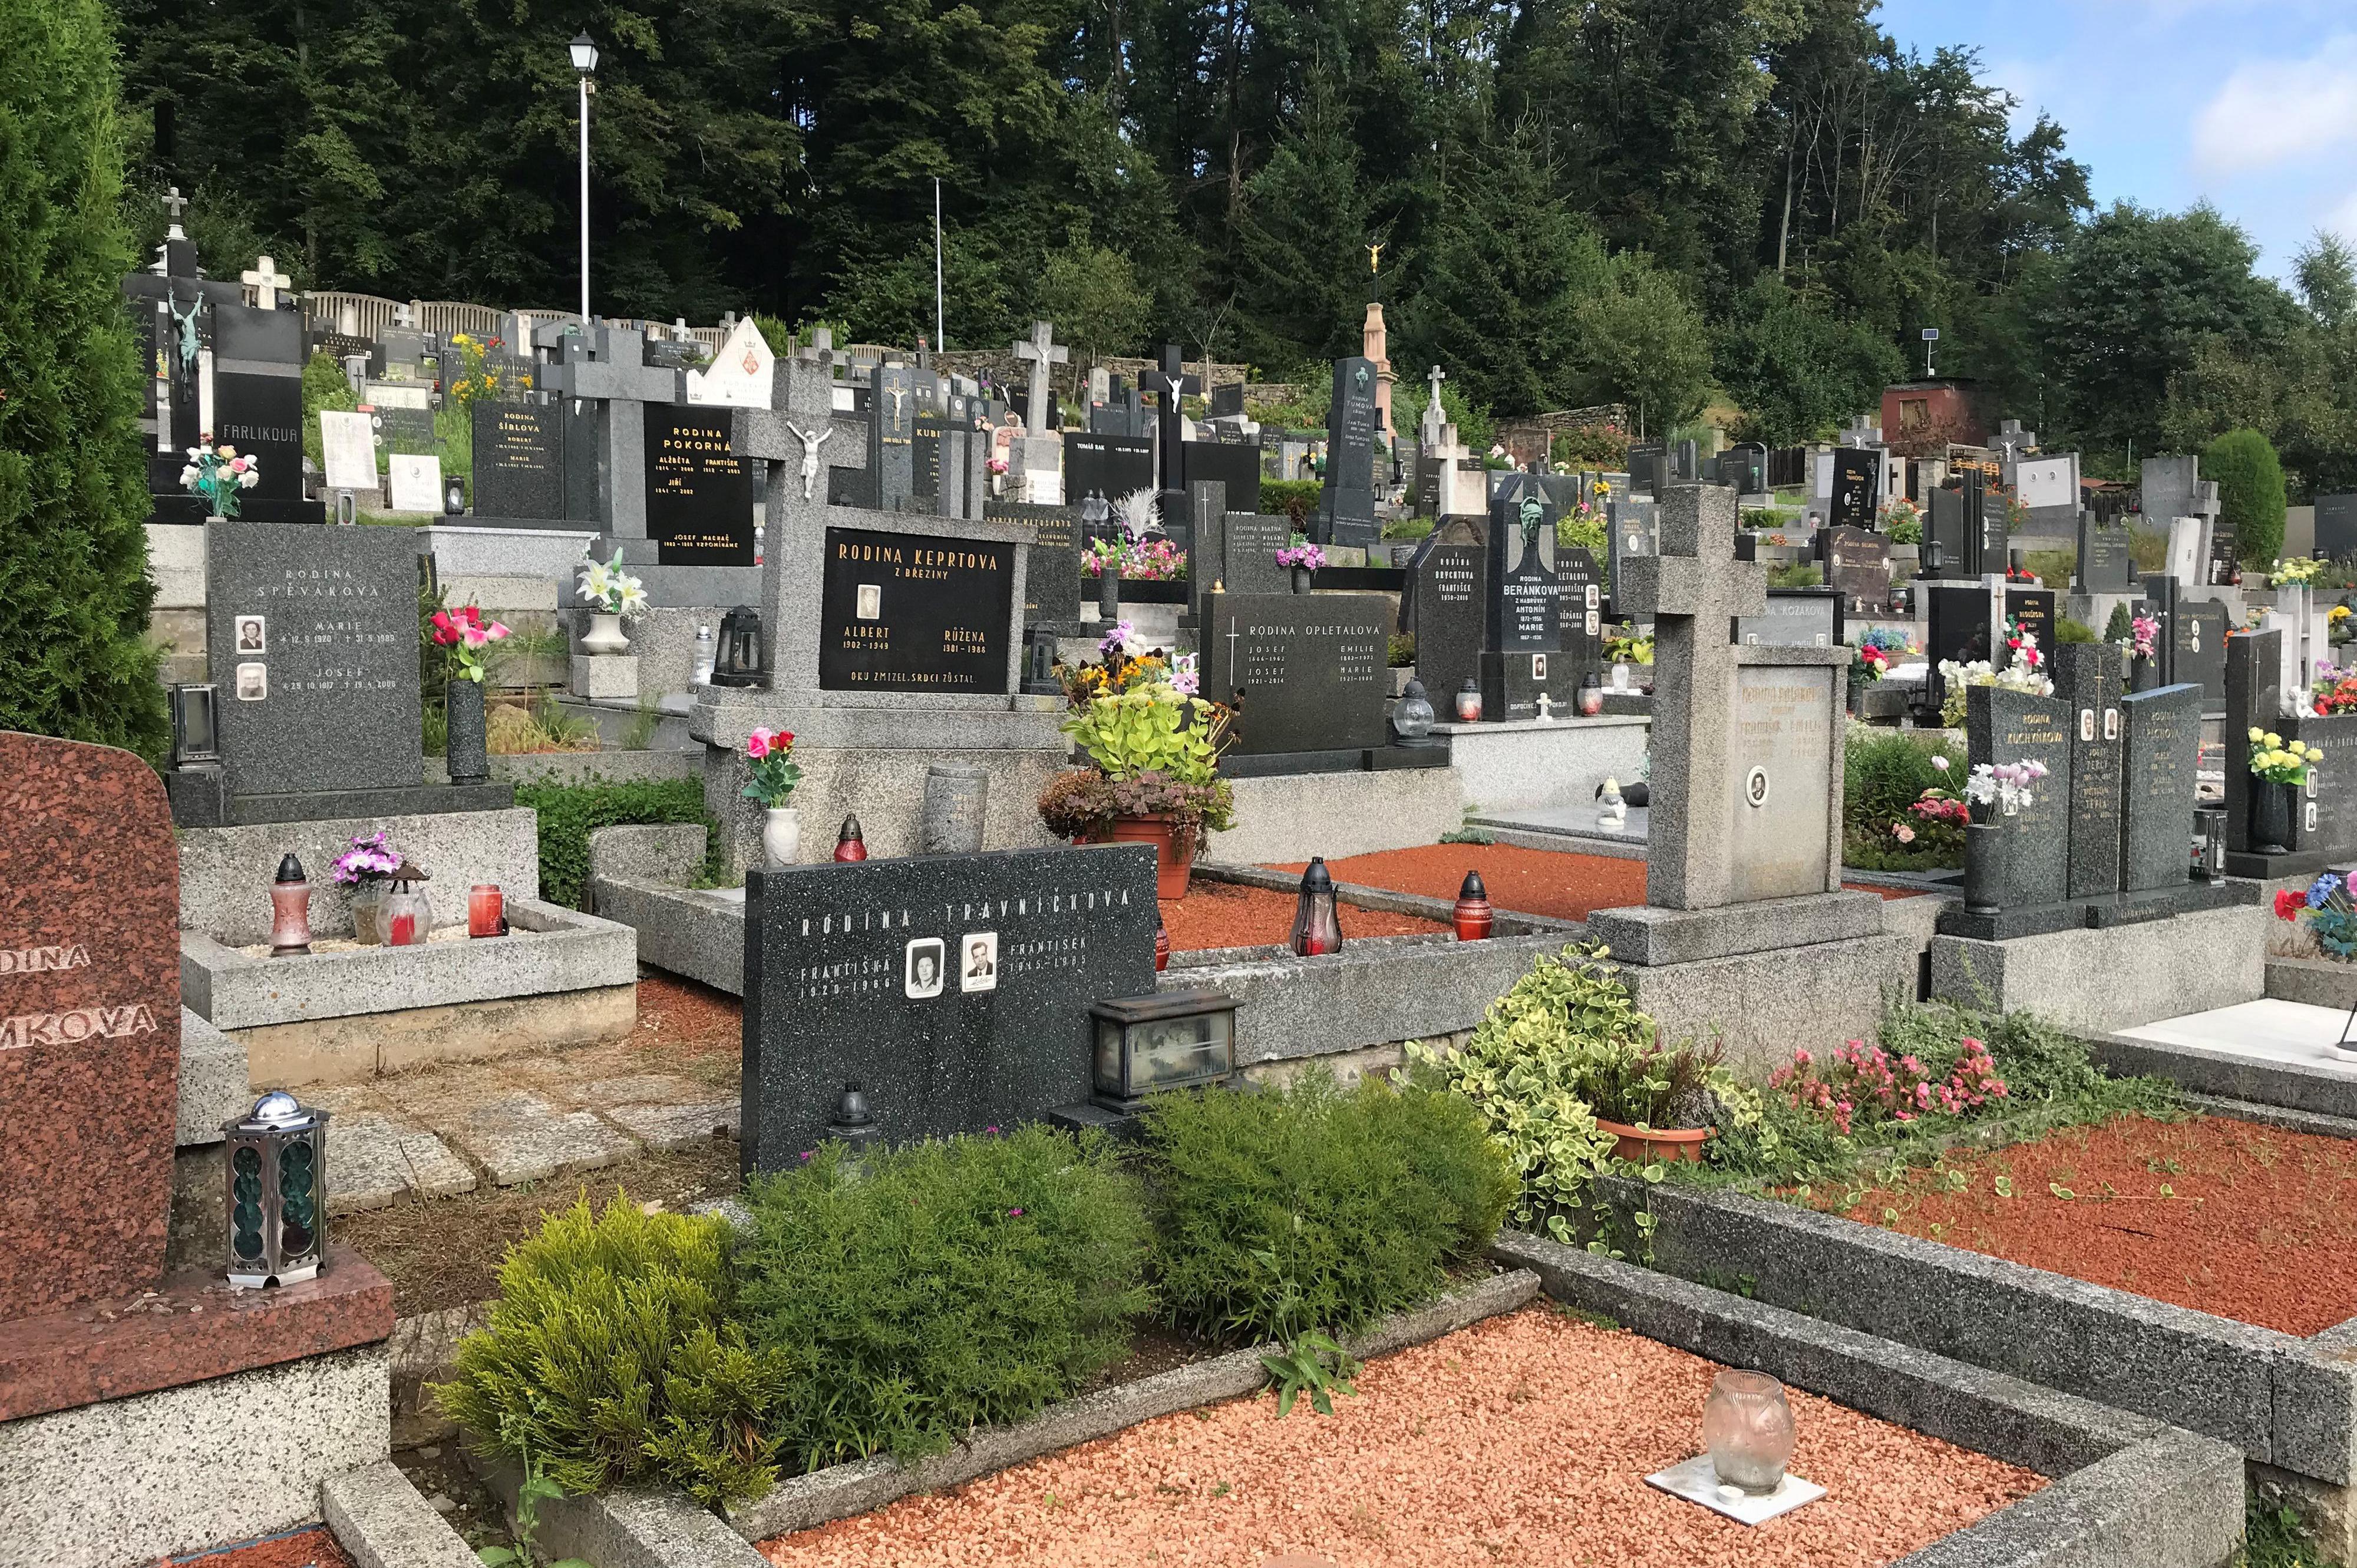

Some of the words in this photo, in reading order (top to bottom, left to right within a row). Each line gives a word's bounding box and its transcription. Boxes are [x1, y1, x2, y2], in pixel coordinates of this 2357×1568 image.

[504, 413, 535, 421] RODINA
[499, 422, 540, 433] ŠÍBLOVA
[674, 428, 722, 438] RODINA
[663, 440, 731, 451] POKORNÁ
[659, 455, 691, 464] ALŽBĚTA
[705, 458, 739, 466] FRANTIŠEK
[668, 478, 682, 486] JIŘÍ
[839, 543, 902, 564] RODINA
[915, 549, 997, 570] KEPRTOVA
[285, 570, 352, 579] RODINA
[895, 567, 900, 577] Z
[905, 567, 948, 580] BŘEZINY
[1558, 572, 1589, 580] LETALOVA
[257, 582, 378, 596] SPĚVÁKOVA
[1438, 582, 1471, 592] FRANTIŠEK
[1503, 582, 1559, 596] BERÁNKOVA
[1557, 583, 1584, 592] RANTIŠEK
[1516, 604, 1546, 613] ANTONÍN
[315, 622, 362, 630] MARIE
[1249, 625, 1296, 635] RODINA
[843, 626, 890, 639] ALBERT
[944, 627, 985, 643] RŮŽENA
[1249, 646, 1285, 654] JOSEF
[315, 668, 364, 678] JOSEF
[851, 671, 869, 681] OKU
[912, 673, 939, 683] SRDCI
[1248, 668, 1285, 676] JOSEF
[2023, 714, 2051, 724] RODINA
[802, 909, 910, 936] RODINA
